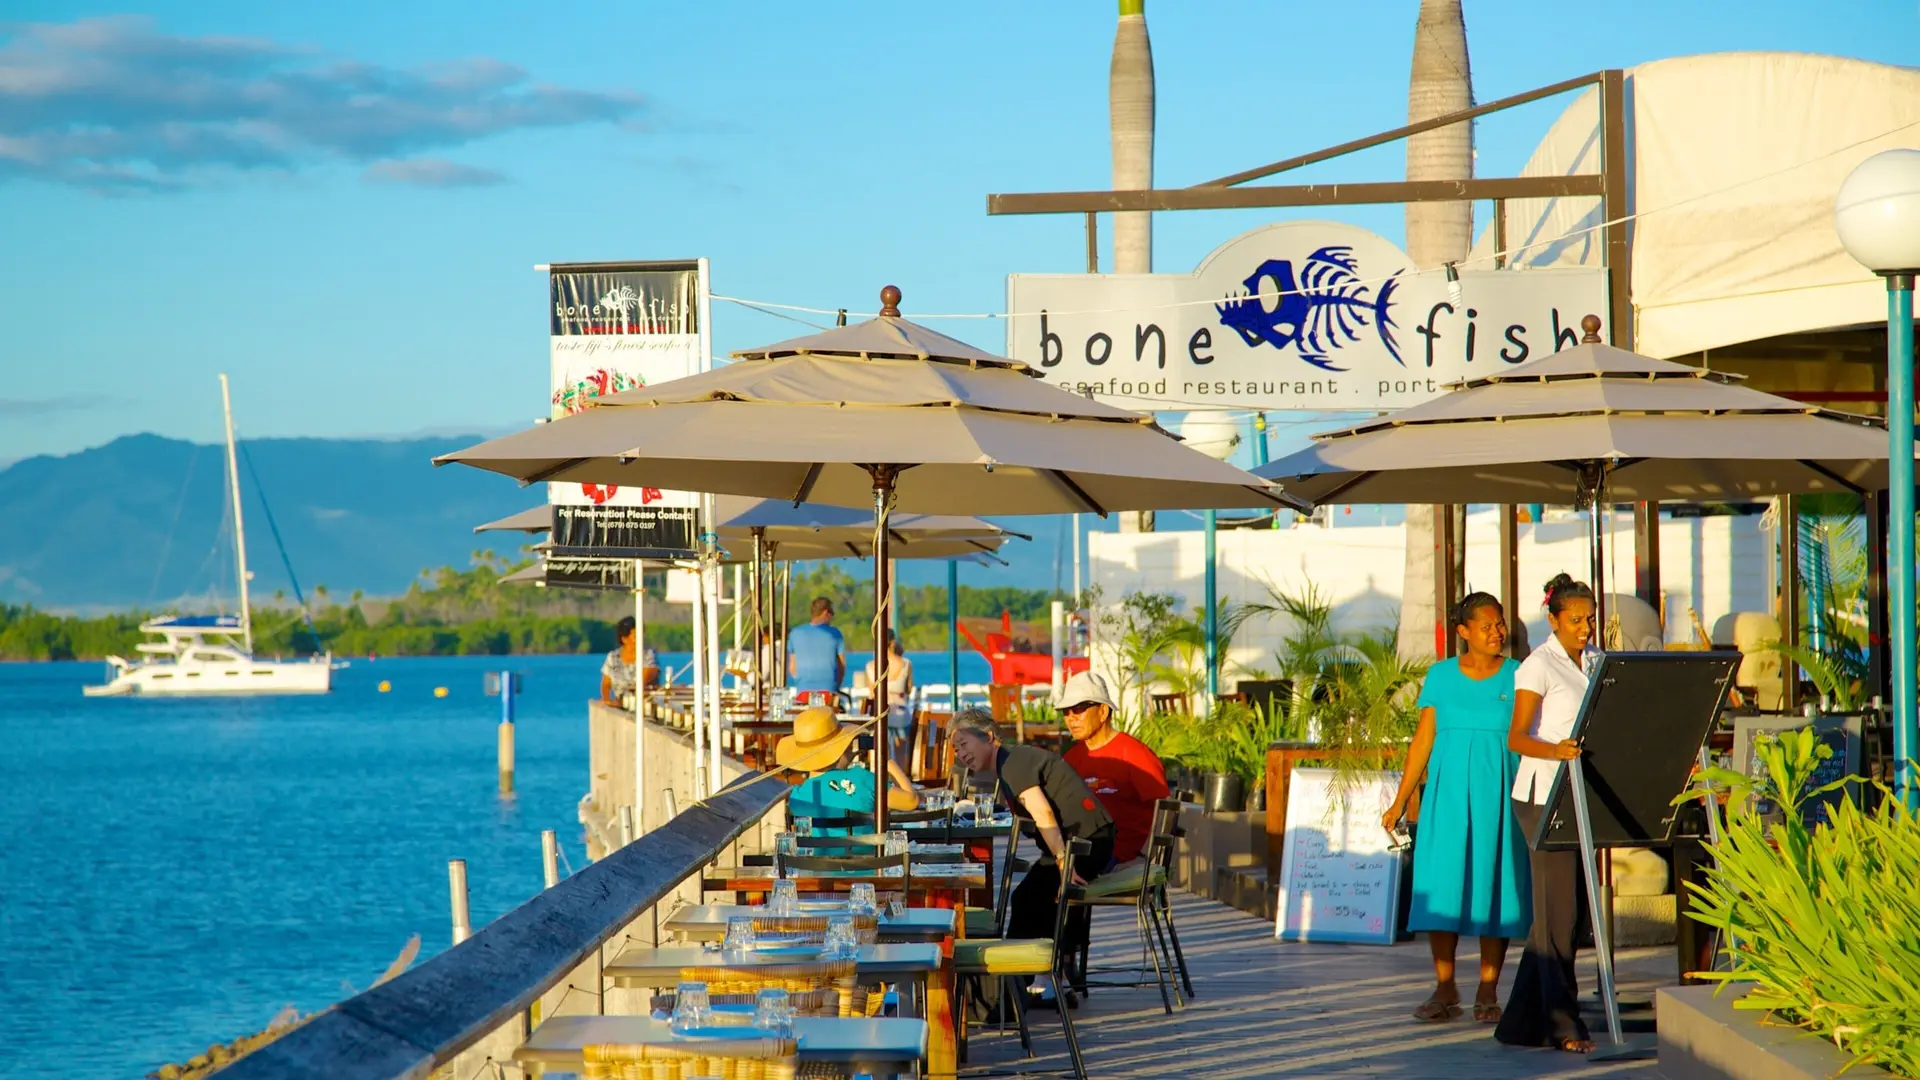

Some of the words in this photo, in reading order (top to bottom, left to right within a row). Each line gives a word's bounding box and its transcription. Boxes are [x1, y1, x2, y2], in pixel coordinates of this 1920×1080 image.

[556, 302, 600, 316] bone
[1040, 309, 1214, 369] bone
[1416, 302, 1579, 368] fish
[1059, 378, 1166, 395] seafood
[1184, 379, 1338, 395] restaurant
[1379, 378, 1436, 396] port
[558, 509, 573, 518] For
[575, 509, 625, 519] Reservation
[627, 510, 656, 519] Please
[658, 511, 693, 521] Contact:
